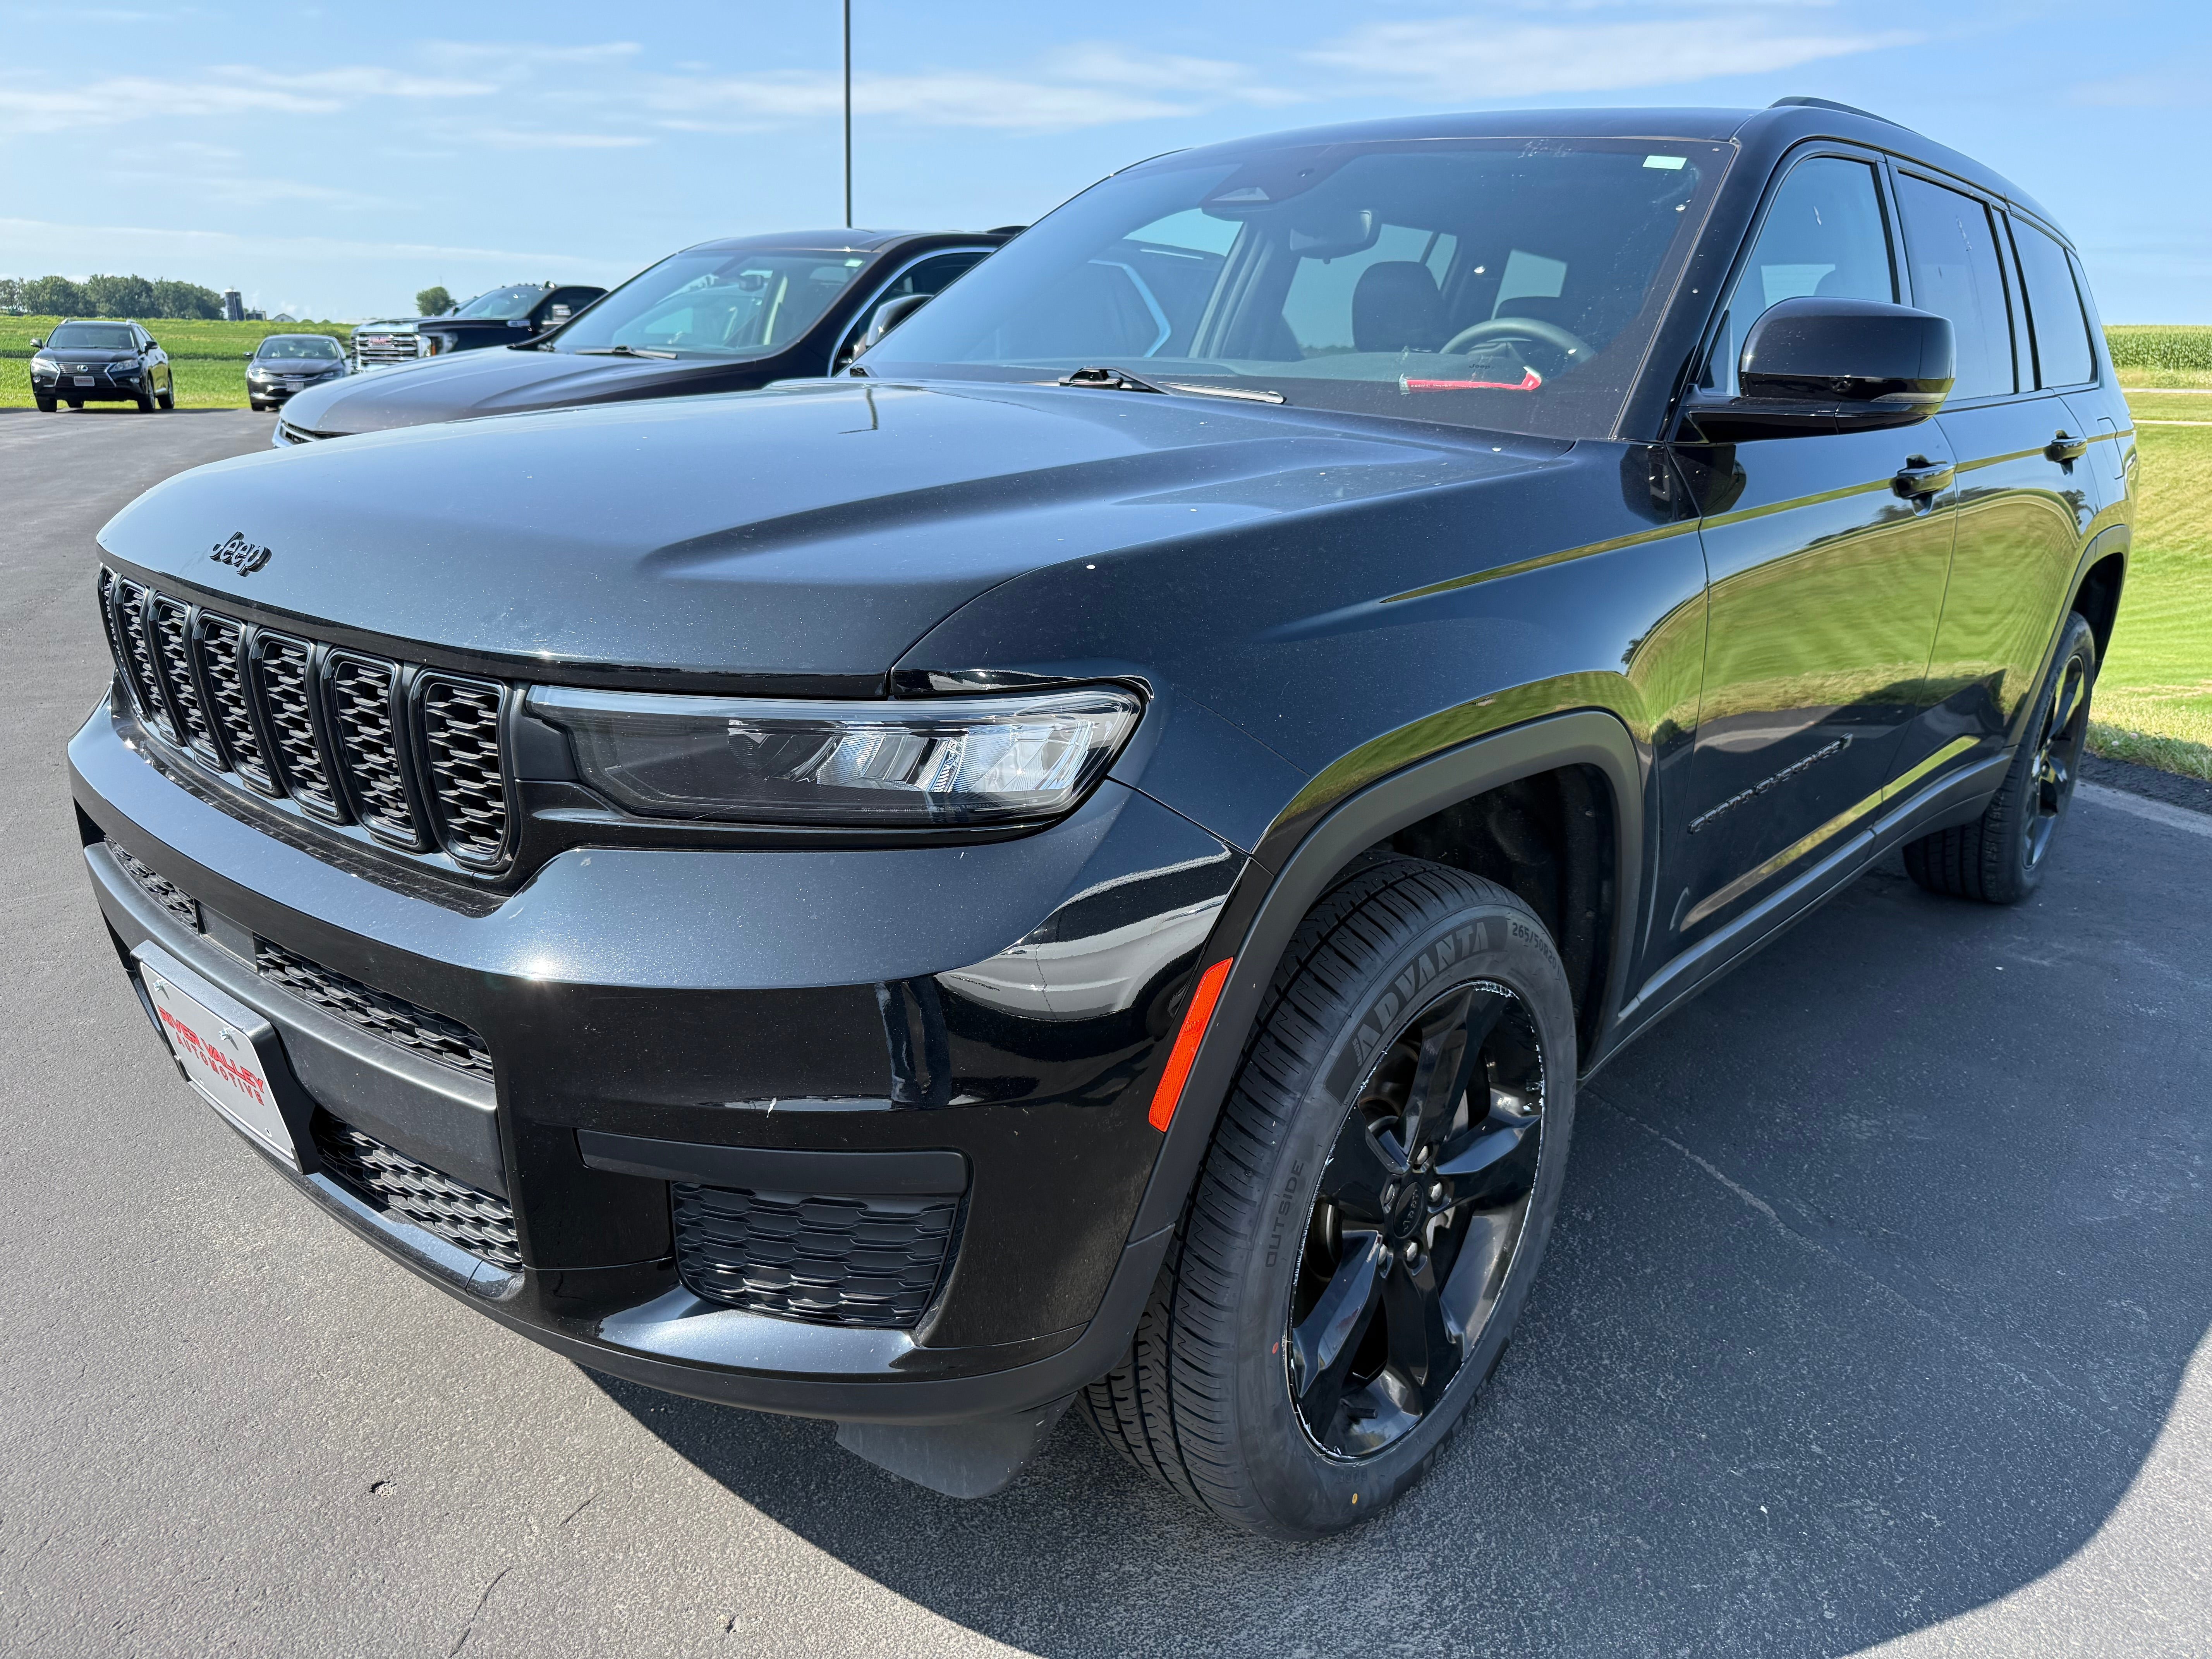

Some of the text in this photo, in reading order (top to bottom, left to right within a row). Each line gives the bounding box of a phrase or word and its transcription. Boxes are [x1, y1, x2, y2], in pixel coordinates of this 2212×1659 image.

[208, 531, 272, 577] Jeep
[1512, 922, 1556, 969] 265/50R20
[1357, 921, 1488, 1062] ADVANTA
[158, 1005, 264, 1094] RIVER VALLEY
[176, 1032, 265, 1106] AUTOMOTIVE
[1265, 1159, 1305, 1267] OUTSIDE
